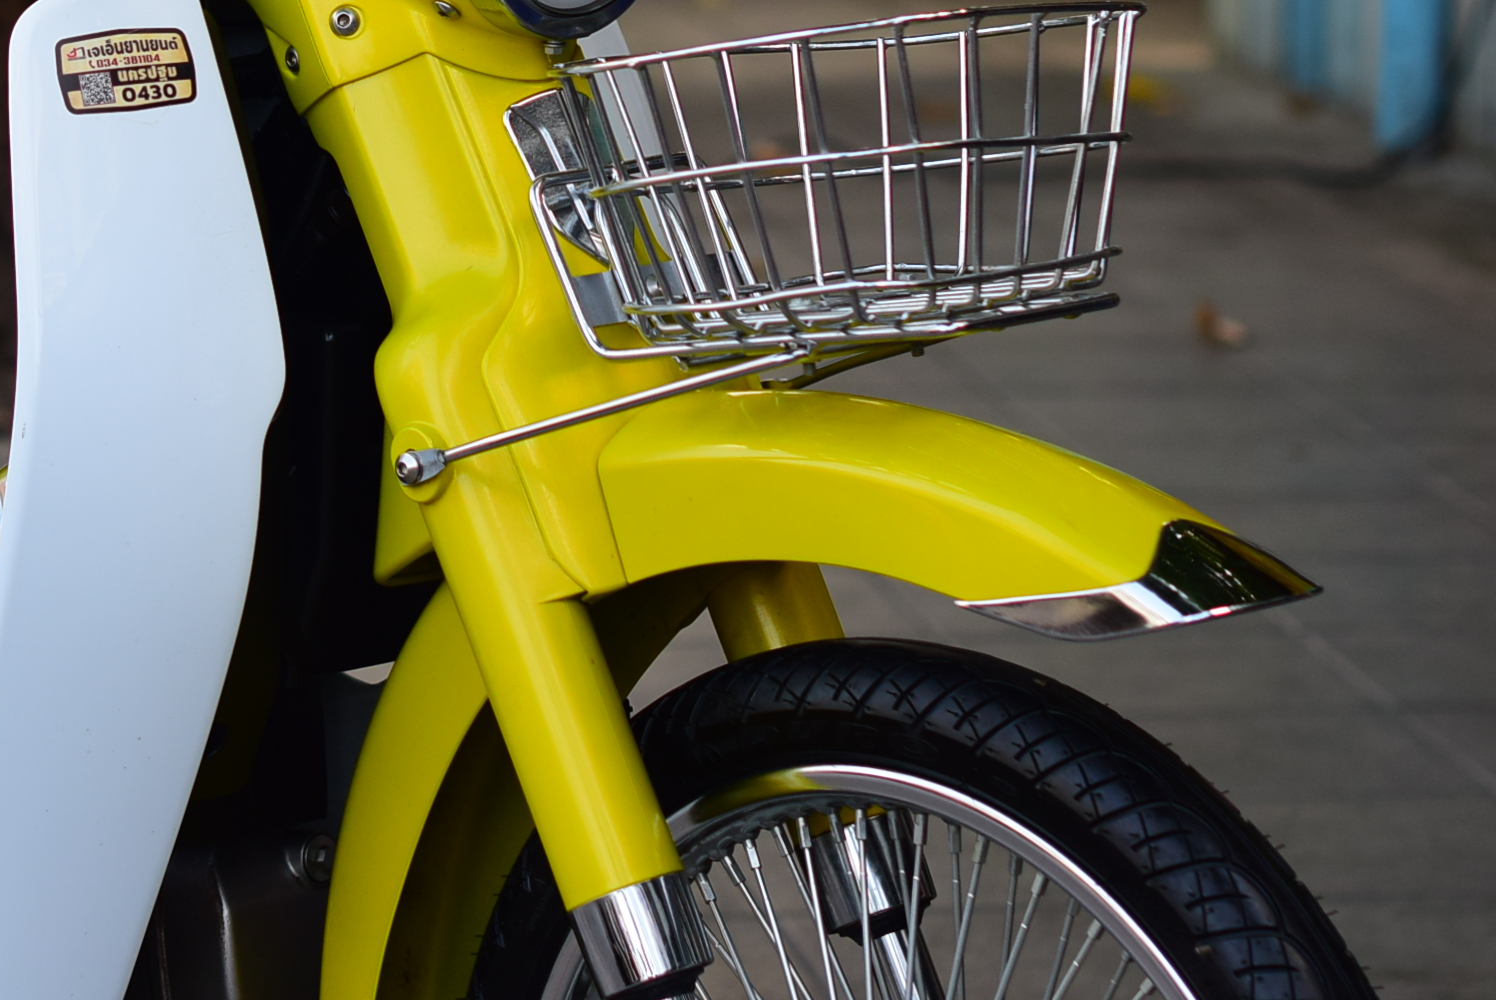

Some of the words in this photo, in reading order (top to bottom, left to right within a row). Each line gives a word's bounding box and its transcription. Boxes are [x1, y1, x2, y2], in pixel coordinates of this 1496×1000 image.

[87, 37, 178, 58] เจเอ็นยานยนต์
[117, 66, 177, 82] นครปฐม
[122, 83, 177, 102] 0430
